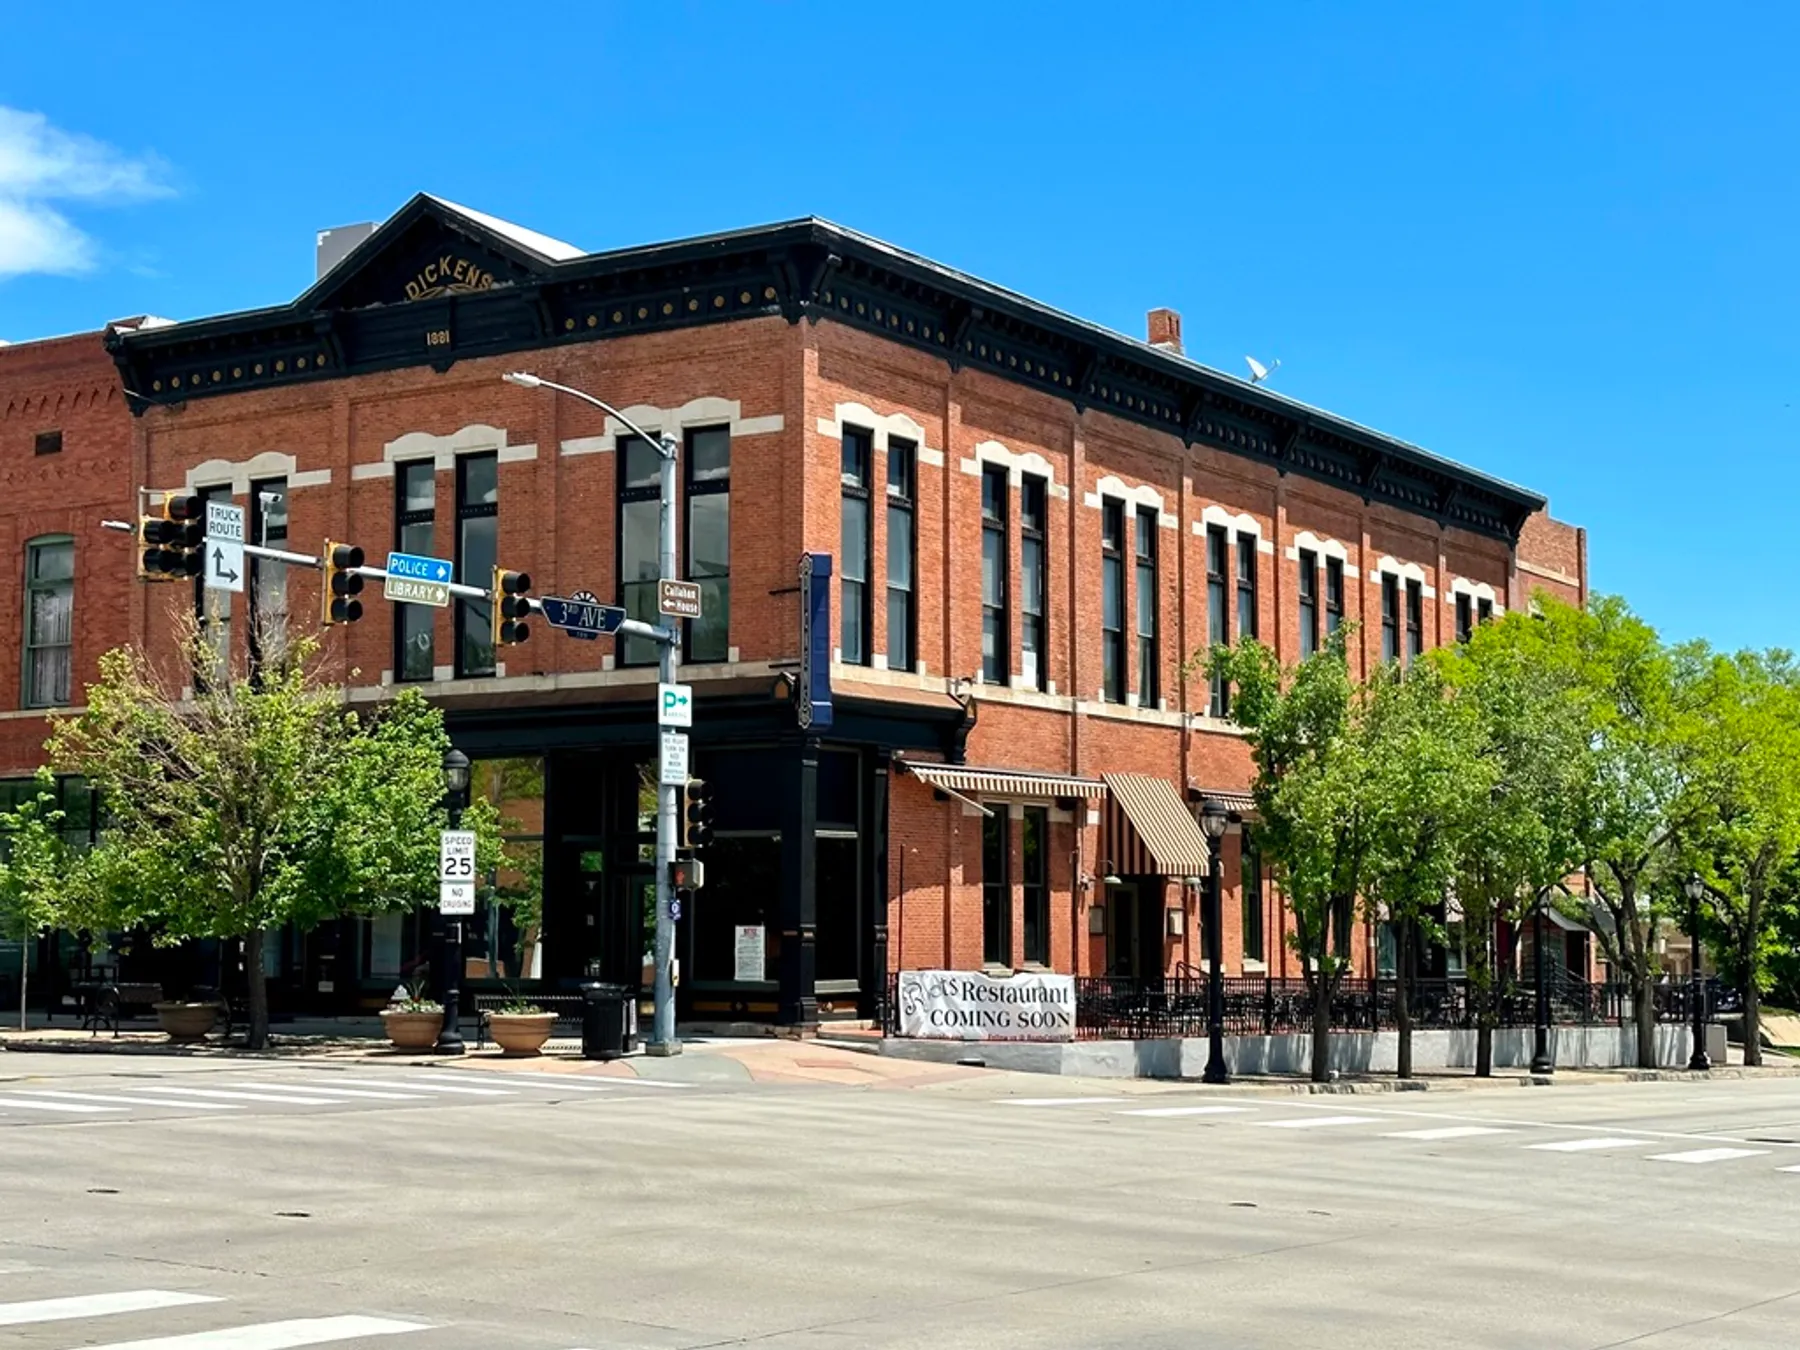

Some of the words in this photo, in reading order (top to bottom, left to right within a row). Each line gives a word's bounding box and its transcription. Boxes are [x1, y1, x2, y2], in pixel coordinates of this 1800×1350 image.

[405, 255, 494, 299] DICKENS
[427, 330, 450, 345] 1881
[210, 506, 241, 521] TRUCK
[210, 521, 241, 537] ROUTE
[391, 557, 429, 576] POLICE
[389, 580, 433, 600] LIBRARY
[665, 584, 696, 598] Callahan
[578, 606, 607, 629] AVE
[445, 836, 472, 845] SPEED
[447, 847, 469, 855] LIMIT
[445, 858, 472, 875] 25
[451, 887, 464, 898] NO
[443, 900, 472, 908] CRUISING
[962, 980, 1068, 1004] Restaurant
[930, 1009, 1011, 1028] COMING
[1017, 1010, 1070, 1029] SOON
